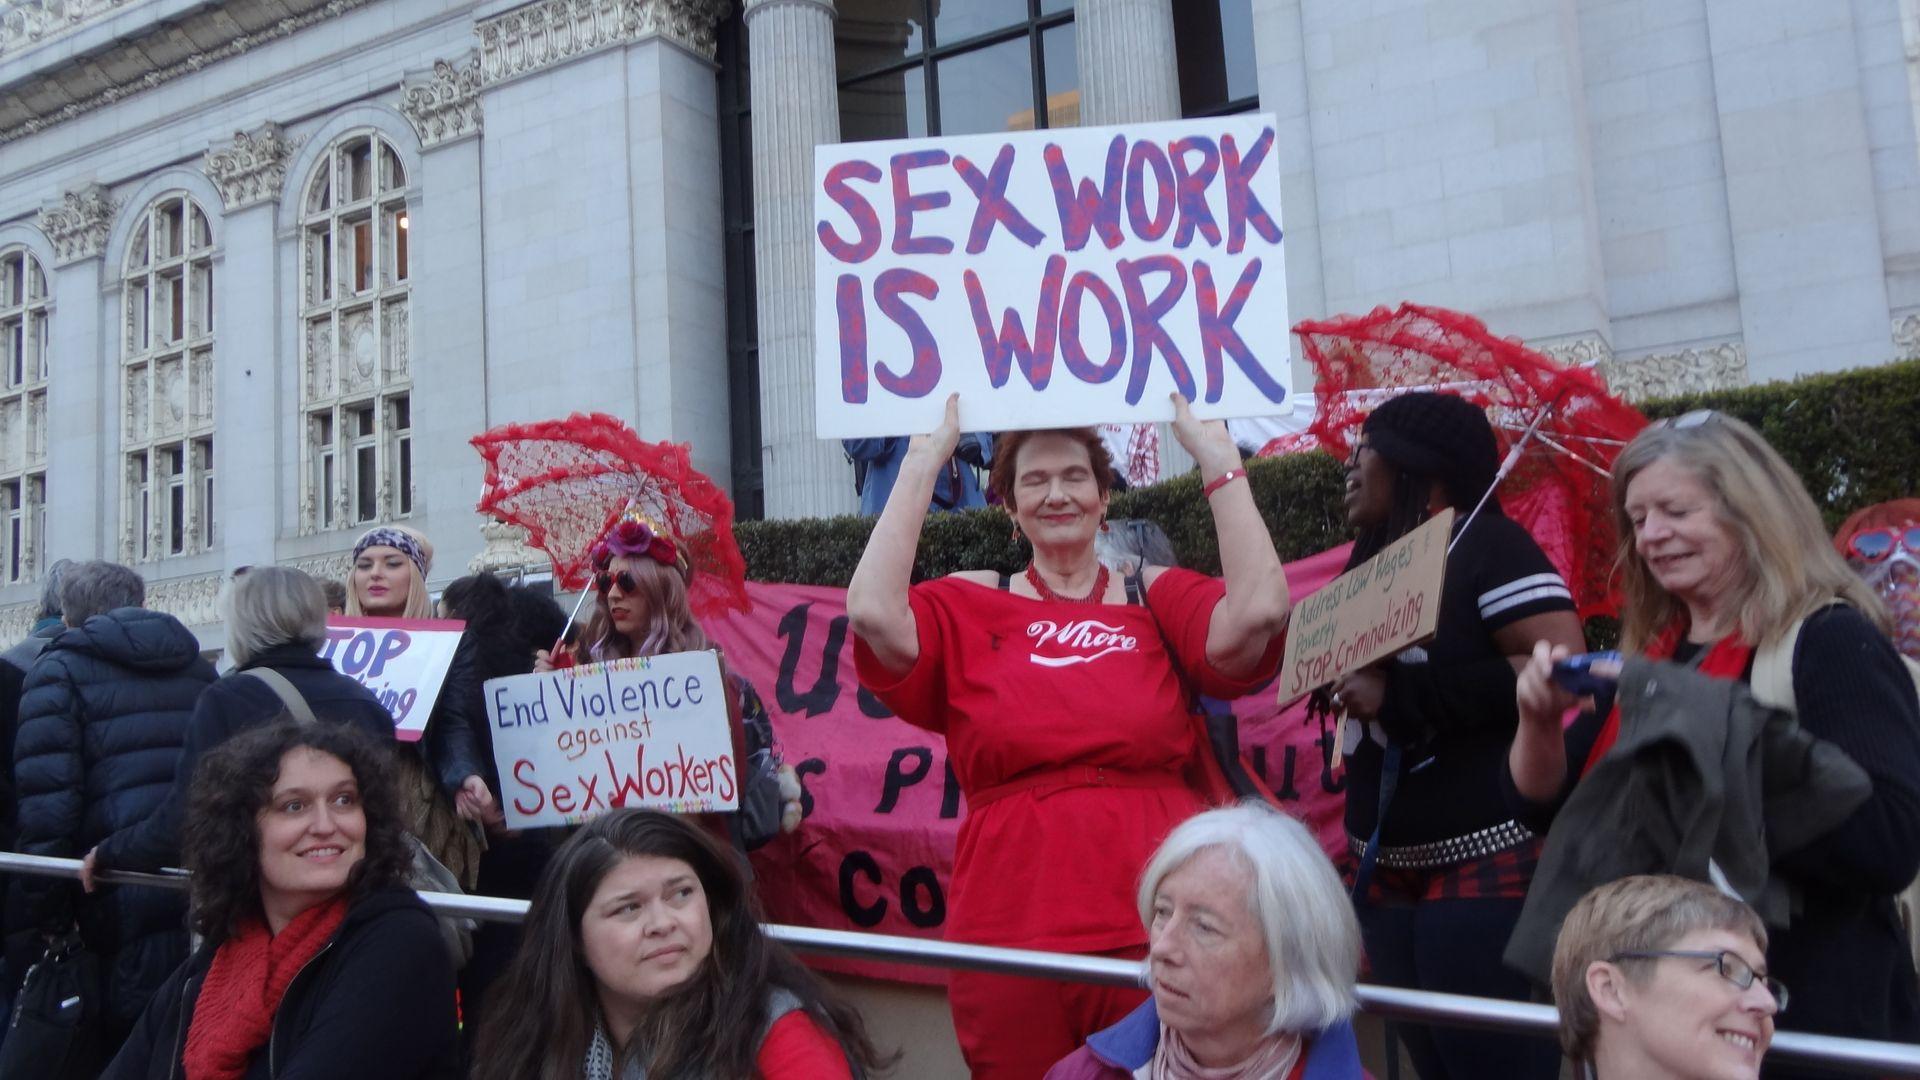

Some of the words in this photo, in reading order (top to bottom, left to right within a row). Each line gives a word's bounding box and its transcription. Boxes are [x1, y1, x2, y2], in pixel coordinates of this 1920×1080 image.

[817, 143, 1046, 264] SEX
[1043, 127, 1283, 254] WORK
[836, 267, 942, 404] IS
[963, 254, 1286, 405] WORK
[1296, 582, 1344, 632] Address
[1346, 563, 1373, 600] Low
[1375, 540, 1415, 593] Wages
[324, 629, 412, 679] TOP
[1026, 619, 1137, 651] Whore
[1292, 650, 1332, 694] STOP
[1335, 588, 1424, 672] Criminalizing
[1294, 613, 1338, 664] Poverty
[495, 678, 549, 729] End
[552, 668, 704, 719] Violence
[557, 710, 652, 761] against
[513, 758, 604, 815] Sex
[604, 743, 735, 808] Workers
